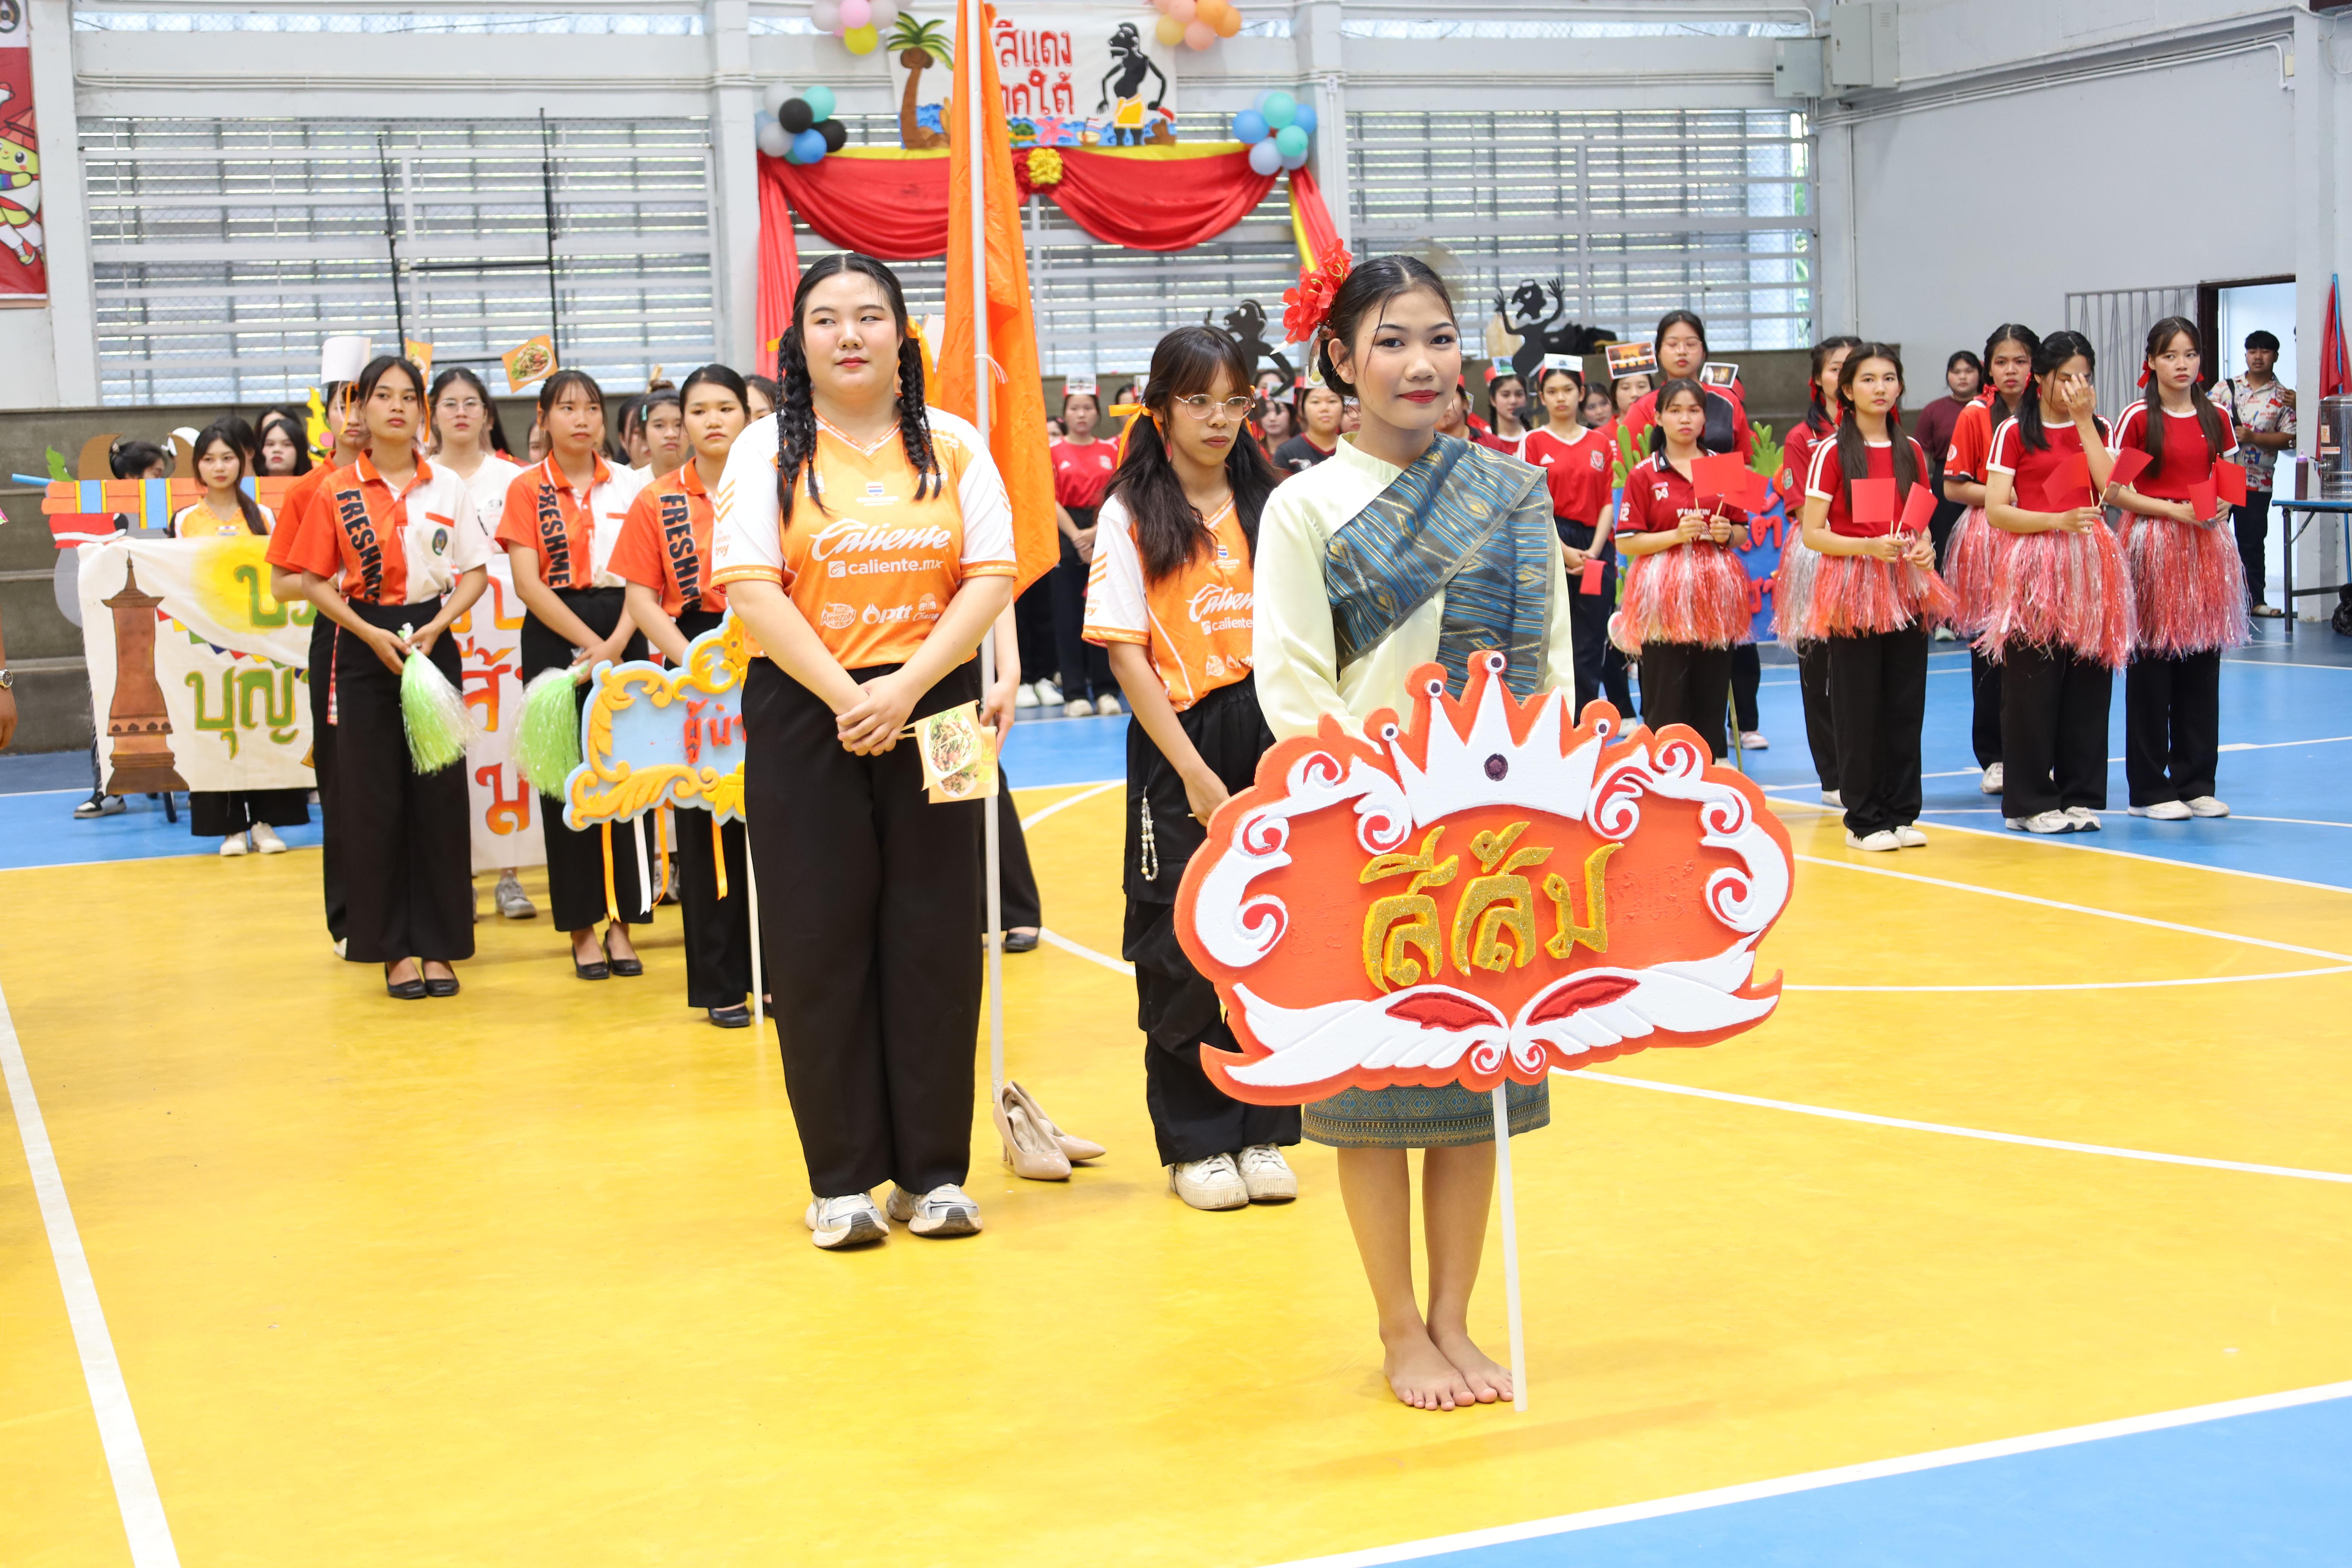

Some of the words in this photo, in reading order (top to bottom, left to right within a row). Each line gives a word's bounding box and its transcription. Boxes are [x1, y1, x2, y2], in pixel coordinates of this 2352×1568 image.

[995, 18, 1072, 67] สีแดง
[809, 518, 951, 561] Caliente
[848, 558, 944, 574] caliente.mx
[913, 612, 940, 622] Chang
[1185, 583, 1254, 622] Calien
[184, 666, 309, 760] บุญ
[1358, 821, 1625, 994] สีส้ม
